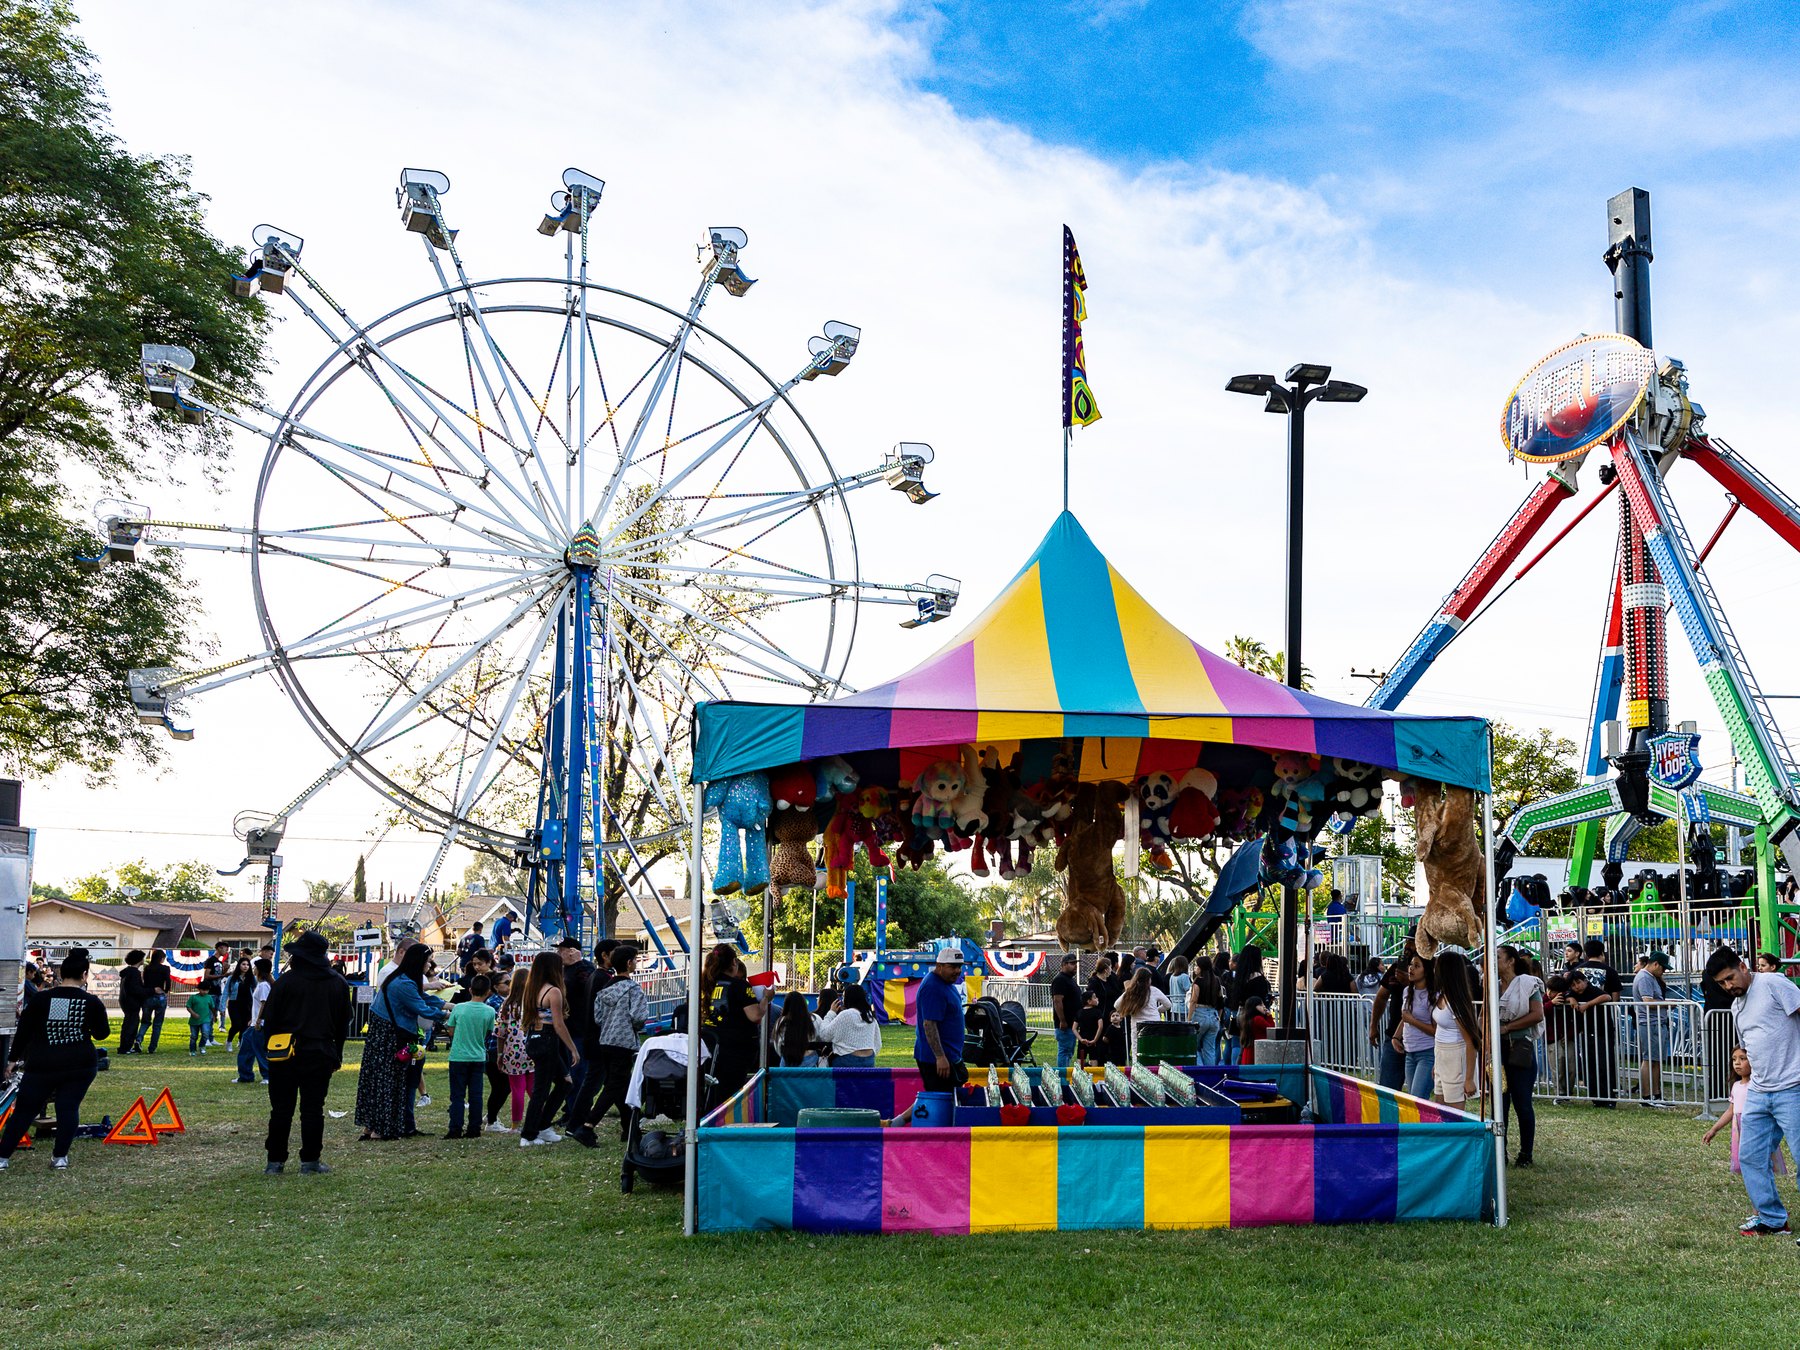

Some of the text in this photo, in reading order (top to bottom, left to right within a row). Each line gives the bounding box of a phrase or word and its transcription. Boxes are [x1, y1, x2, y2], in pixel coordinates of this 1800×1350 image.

[1508, 347, 1656, 465] HYPER LOOP
[1655, 740, 1687, 762] HYPER
[1658, 756, 1687, 780] LOOP
